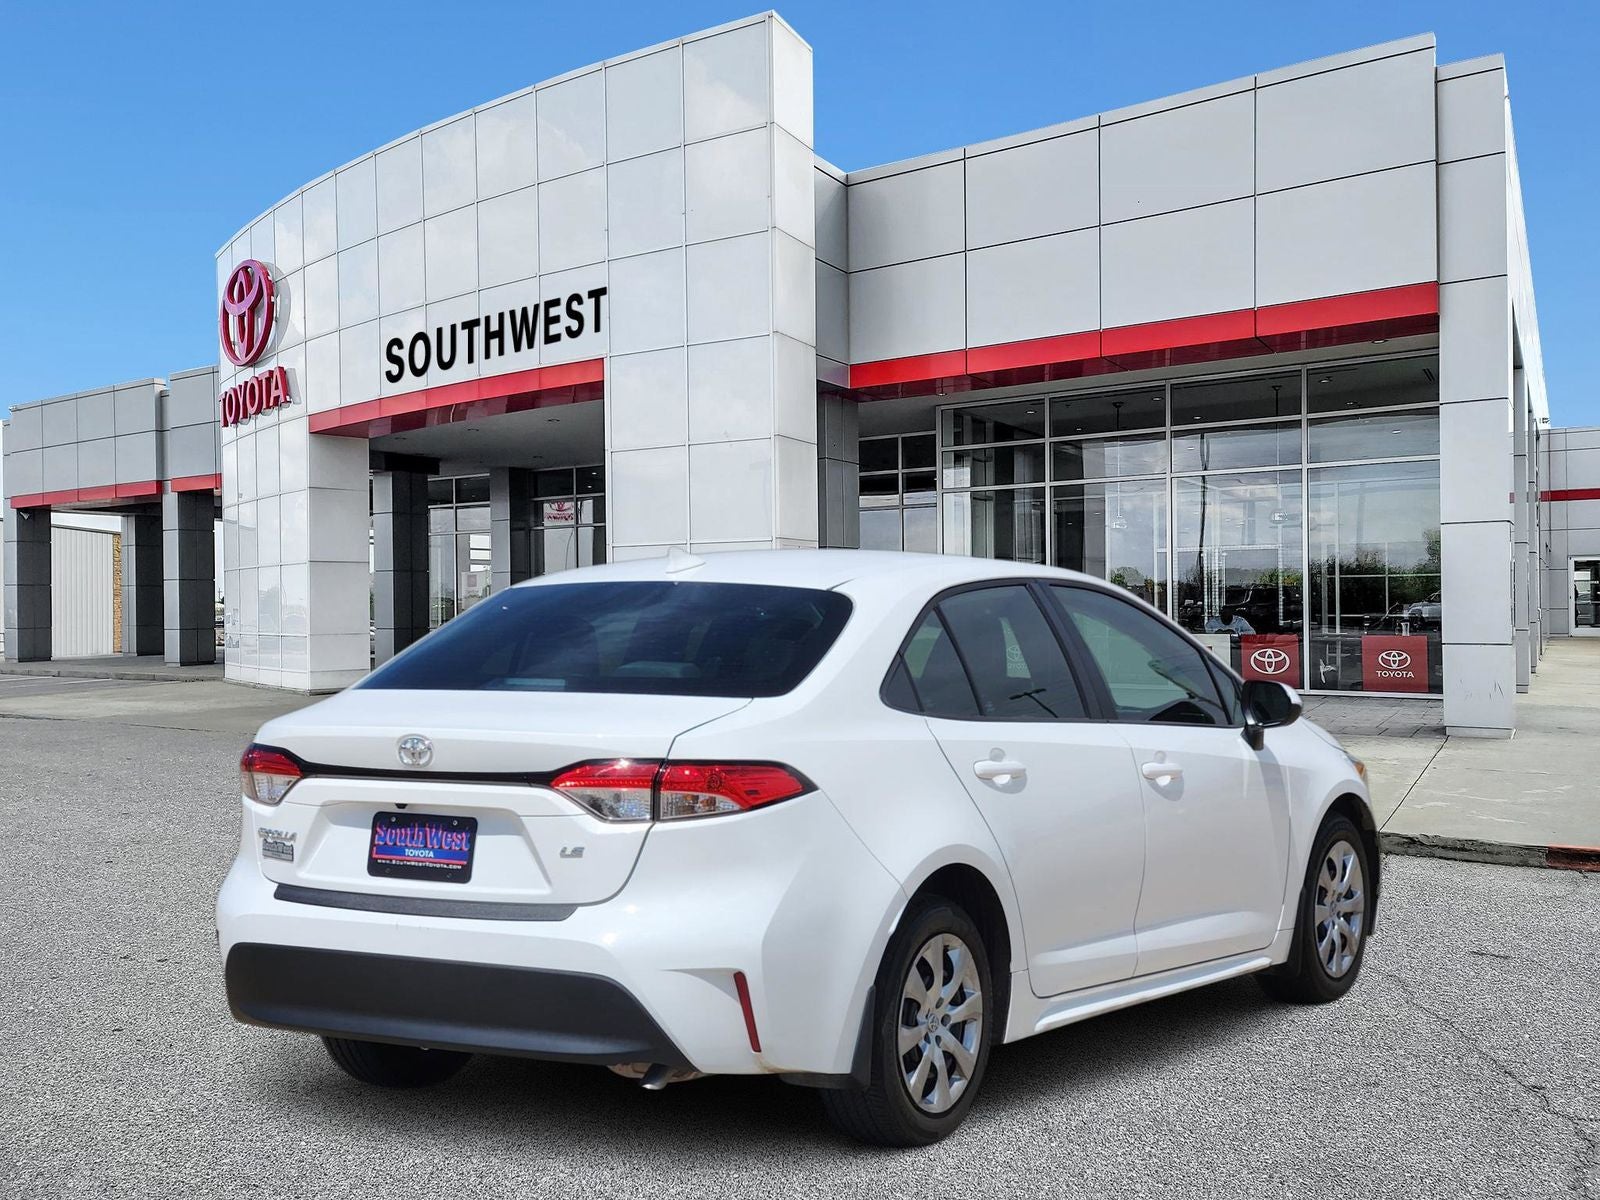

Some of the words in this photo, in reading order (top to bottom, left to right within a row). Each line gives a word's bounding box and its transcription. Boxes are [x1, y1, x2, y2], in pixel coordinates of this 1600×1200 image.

[385, 286, 608, 384] SOUTHWEST
[218, 366, 292, 428] TOYOTA
[1376, 670, 1415, 678] TOYOTA
[404, 848, 435, 858] TOYOTA
[559, 846, 585, 859] LE
